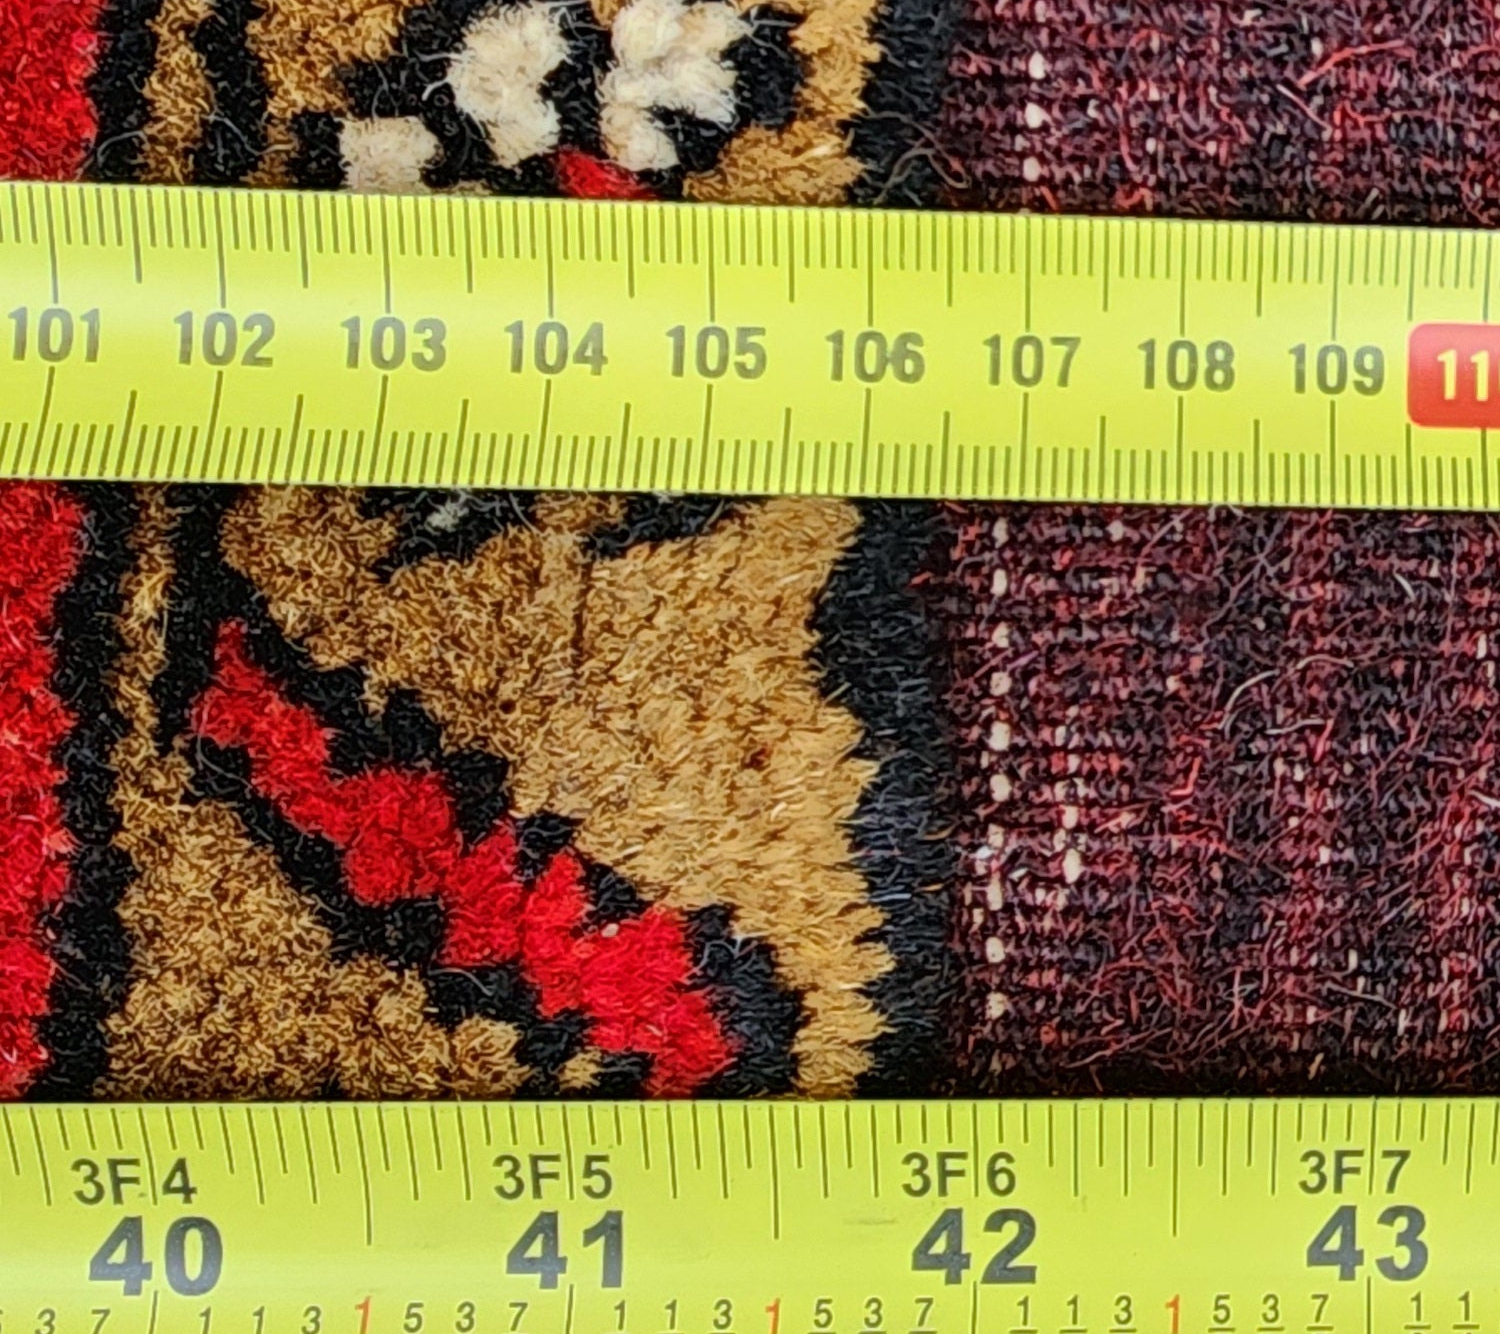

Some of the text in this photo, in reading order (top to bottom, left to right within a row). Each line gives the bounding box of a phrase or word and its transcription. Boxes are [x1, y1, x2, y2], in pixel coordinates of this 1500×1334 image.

[13, 308, 99, 362] 101
[176, 312, 274, 366] 102
[343, 317, 445, 371] 103
[506, 321, 608, 375] 104
[667, 326, 766, 379] 105
[827, 330, 924, 383] 106
[984, 334, 1080, 387] 107
[1139, 339, 1234, 391] 108
[1290, 344, 1384, 395] 109
[89, 1216, 223, 1296] 40
[506, 1210, 623, 1289] 41
[912, 1208, 1037, 1285] 42
[1306, 1205, 1428, 1281] 43
